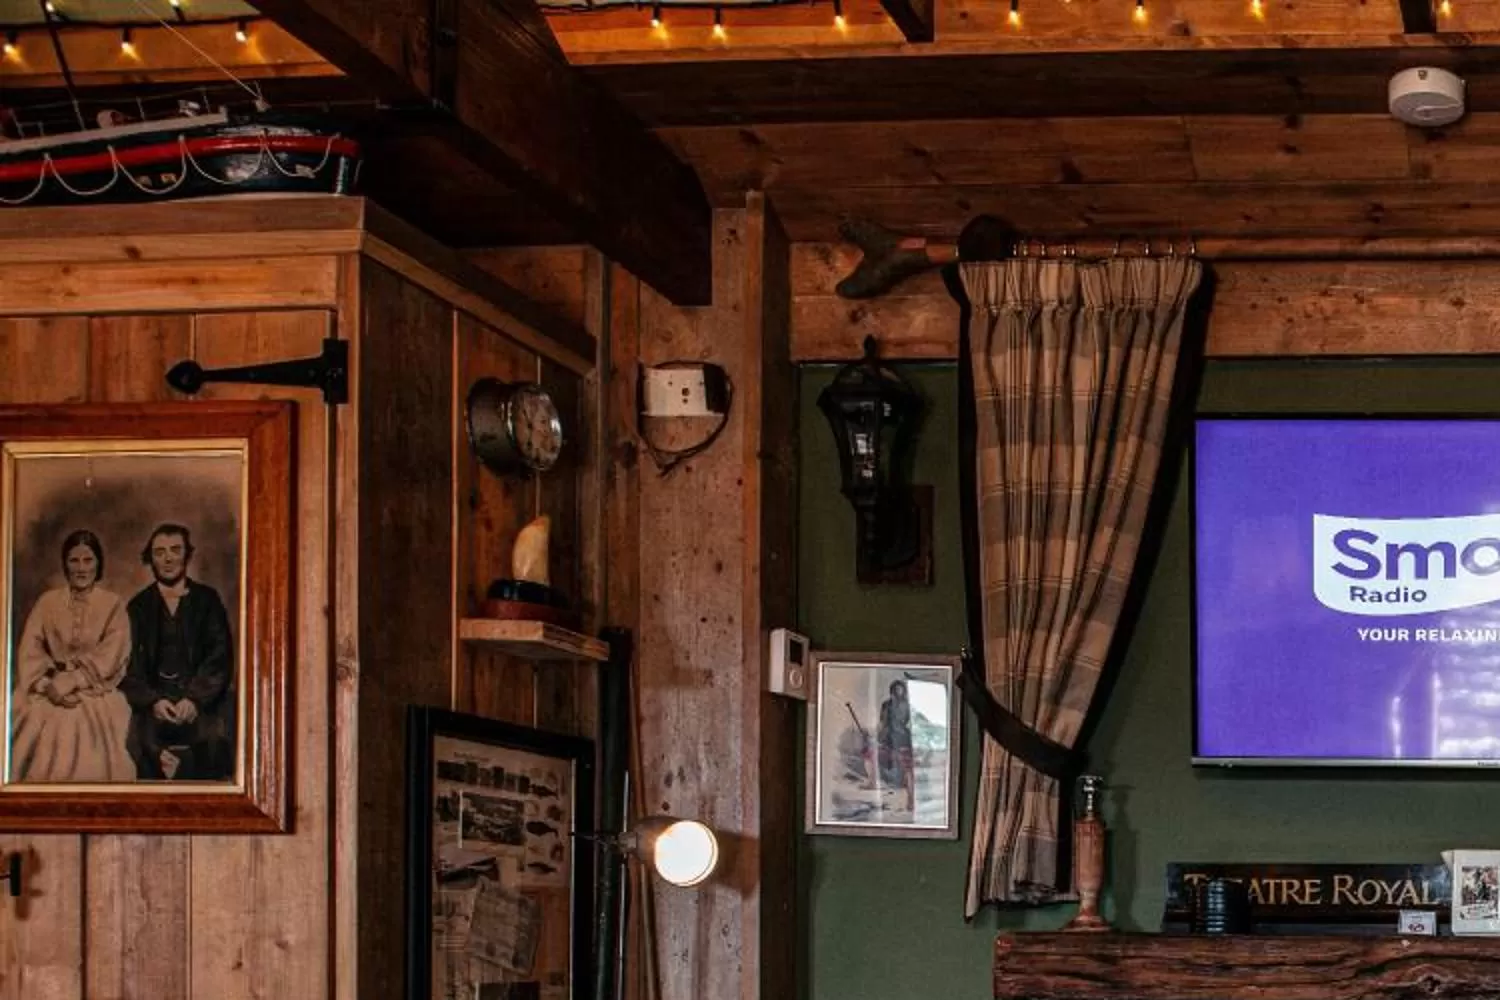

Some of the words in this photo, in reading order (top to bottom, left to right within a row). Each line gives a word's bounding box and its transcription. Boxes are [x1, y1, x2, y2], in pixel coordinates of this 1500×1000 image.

[1349, 585, 1428, 604] Radio
[1358, 628, 1409, 642] YOUR
[1333, 875, 1441, 905] ROYAL
